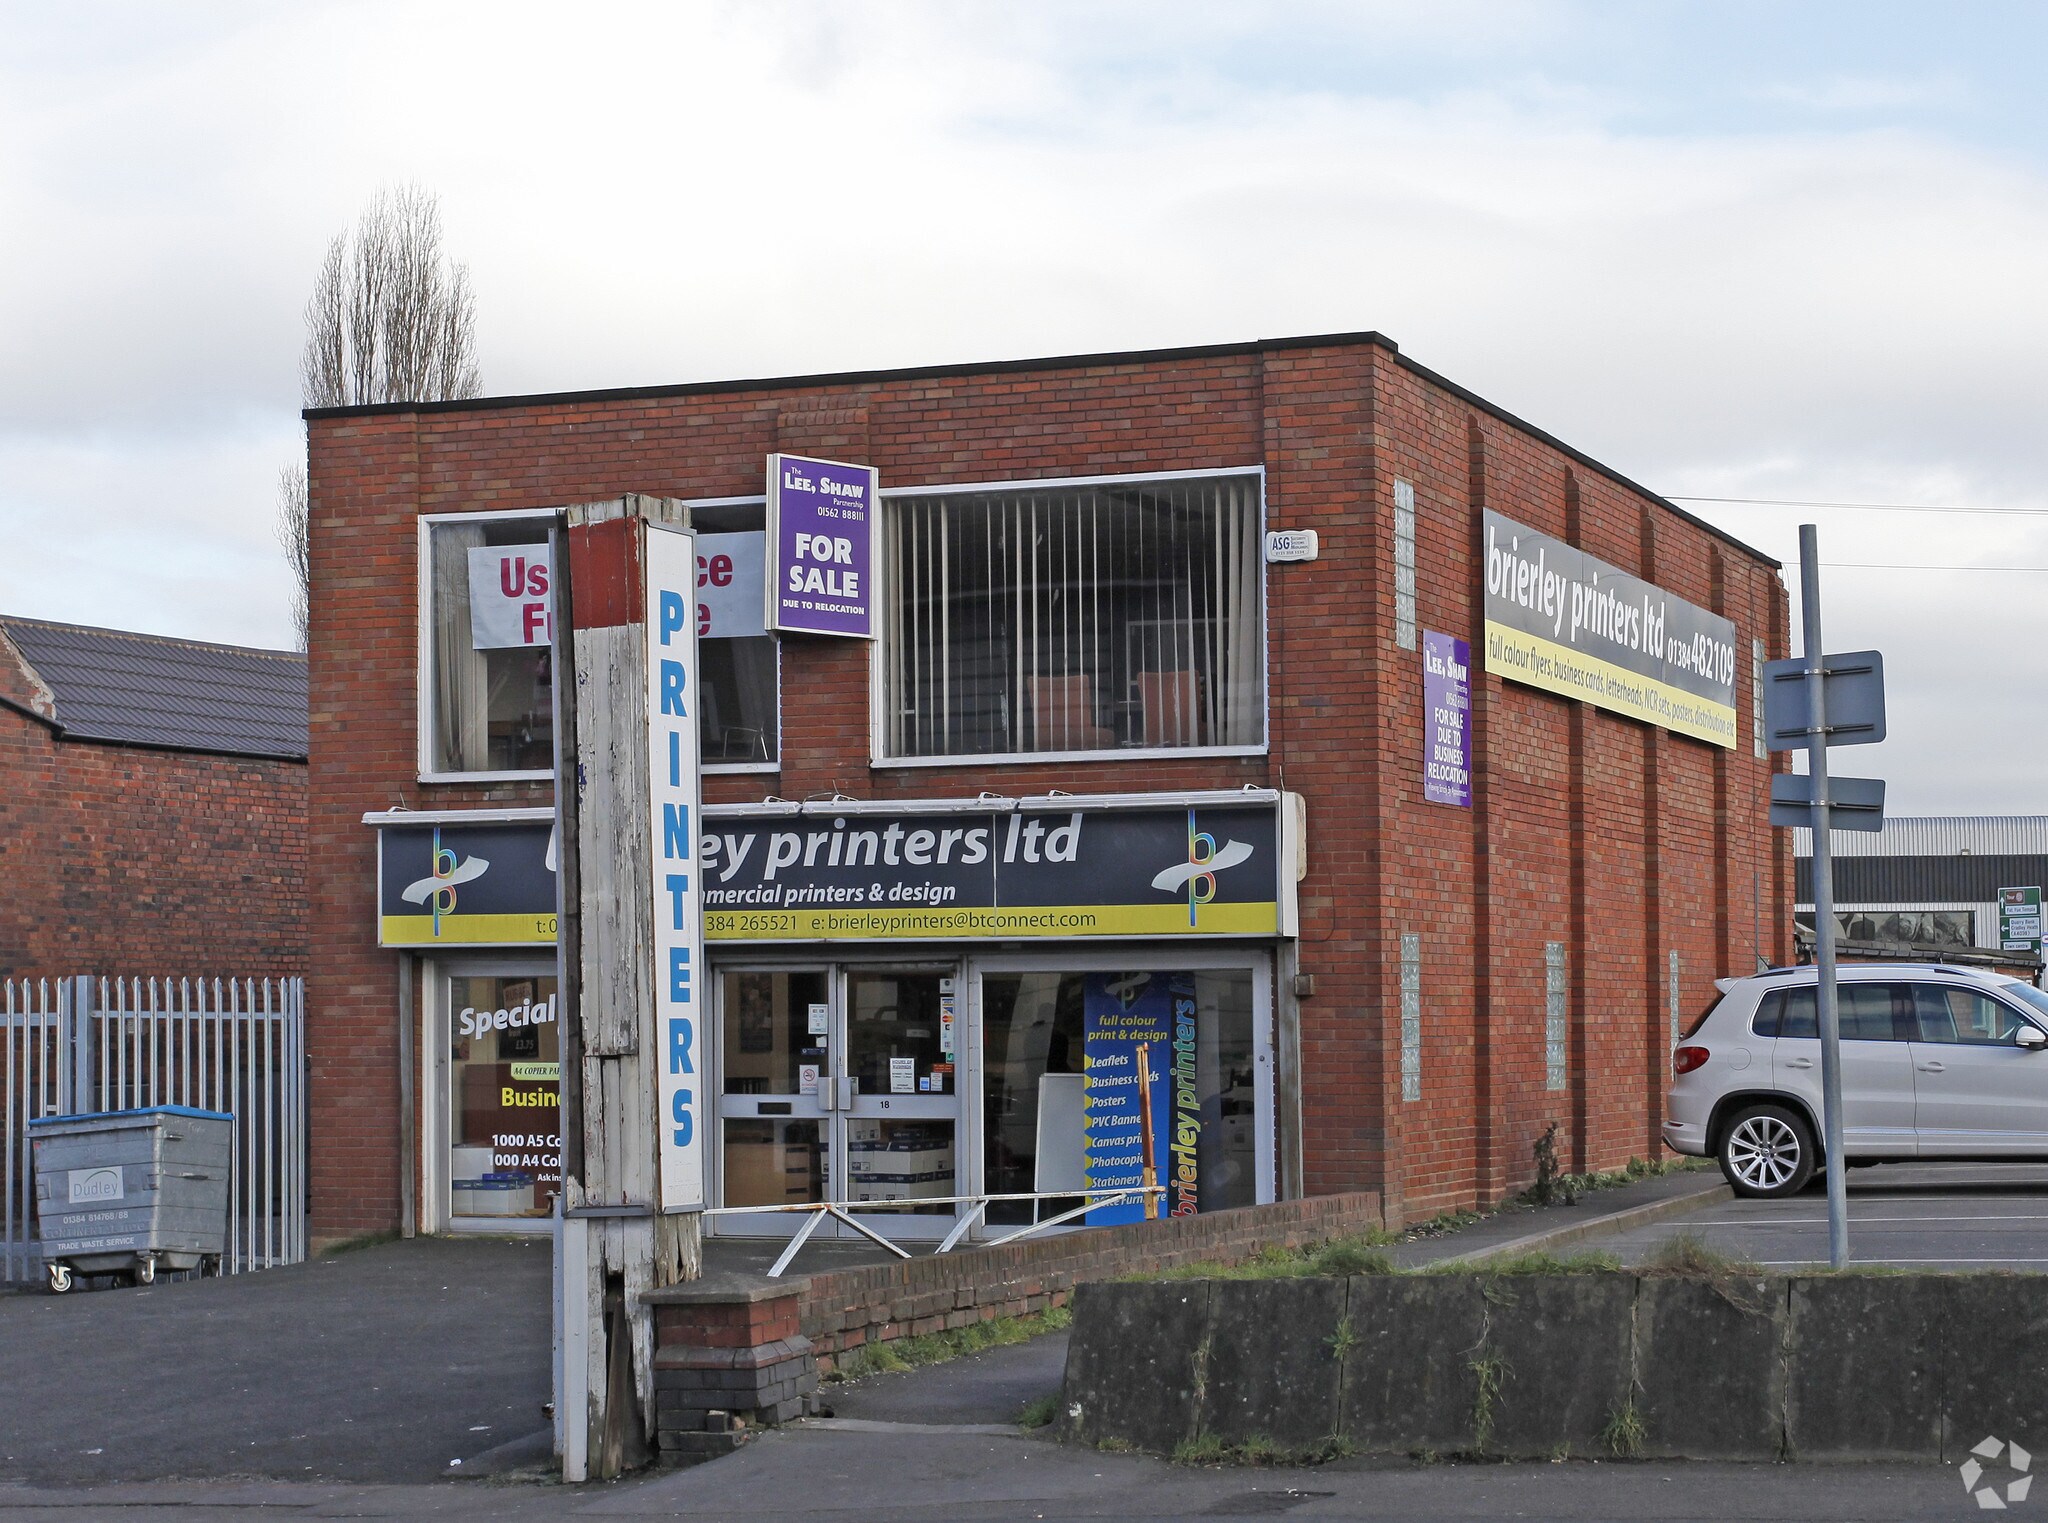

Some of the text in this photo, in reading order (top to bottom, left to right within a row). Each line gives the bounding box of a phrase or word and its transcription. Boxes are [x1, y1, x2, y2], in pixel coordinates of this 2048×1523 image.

[791, 467, 801, 475] The
[820, 477, 864, 498] SHAW
[833, 498, 864, 509] Partnership
[817, 507, 864, 521] 01562 888111
[796, 533, 852, 564] FOR
[1272, 537, 1290, 550] ASG
[501, 556, 549, 598] Us
[789, 566, 859, 598] SALE
[783, 599, 865, 615] DUE TO RELOCATION
[1488, 525, 1734, 687] brierley printers ltd 01384 482109
[1489, 632, 1503, 660] full
[1504, 640, 1529, 670] colour
[1531, 646, 1553, 680] flyers,
[1554, 654, 1584, 686] business
[1585, 669, 1605, 698] cards,
[1606, 672, 1644, 711] letterheads,
[1645, 687, 1658, 713] NCR
[1658, 697, 1671, 720] sets,
[1672, 703, 1694, 726] posters,
[1695, 705, 1725, 734] distribution
[1435, 707, 1464, 730] FOR SALE
[1437, 727, 1462, 747] DUE TO
[1434, 745, 1464, 767] BUSINESS
[1428, 762, 1468, 786] RELOCATION
[765, 818, 988, 880] printers
[1004, 813, 1083, 863] ltd
[661, 590, 693, 1148] PRINTERS
[703, 881, 956, 907] mercial printers & design
[706, 911, 735, 932] 384
[740, 911, 797, 931] 265521
[828, 910, 1097, 934] brierleyprinters@btconnect.com
[1099, 1014, 1157, 1026] full colour
[1088, 1029, 1167, 1042] print & design
[1092, 1055, 1128, 1068] Leaflets
[1170, 999, 1200, 1110] printers
[514, 1067, 522, 1075] A4
[524, 1066, 547, 1075] COPIER
[1092, 1071, 1159, 1088] Business cds
[880, 1101, 890, 1109] 18
[1092, 1096, 1126, 1108] Posters
[1092, 1115, 1141, 1128] PVC Banne
[492, 1134, 560, 1147] 1000 A5 Co
[1092, 1132, 1155, 1148] Canvas pris
[488, 1154, 561, 1167] 1000 A4 Col
[1092, 1152, 1143, 1168] Photocopie
[1170, 1111, 1201, 1218] brierley
[537, 1173, 551, 1182] Ask
[1092, 1175, 1143, 1188] Stationery
[74, 1182, 118, 1198] Dudley
[63, 1210, 129, 1225] 01384 814768/88
[58, 1236, 135, 1250] TRADE WASTE SERVICE
